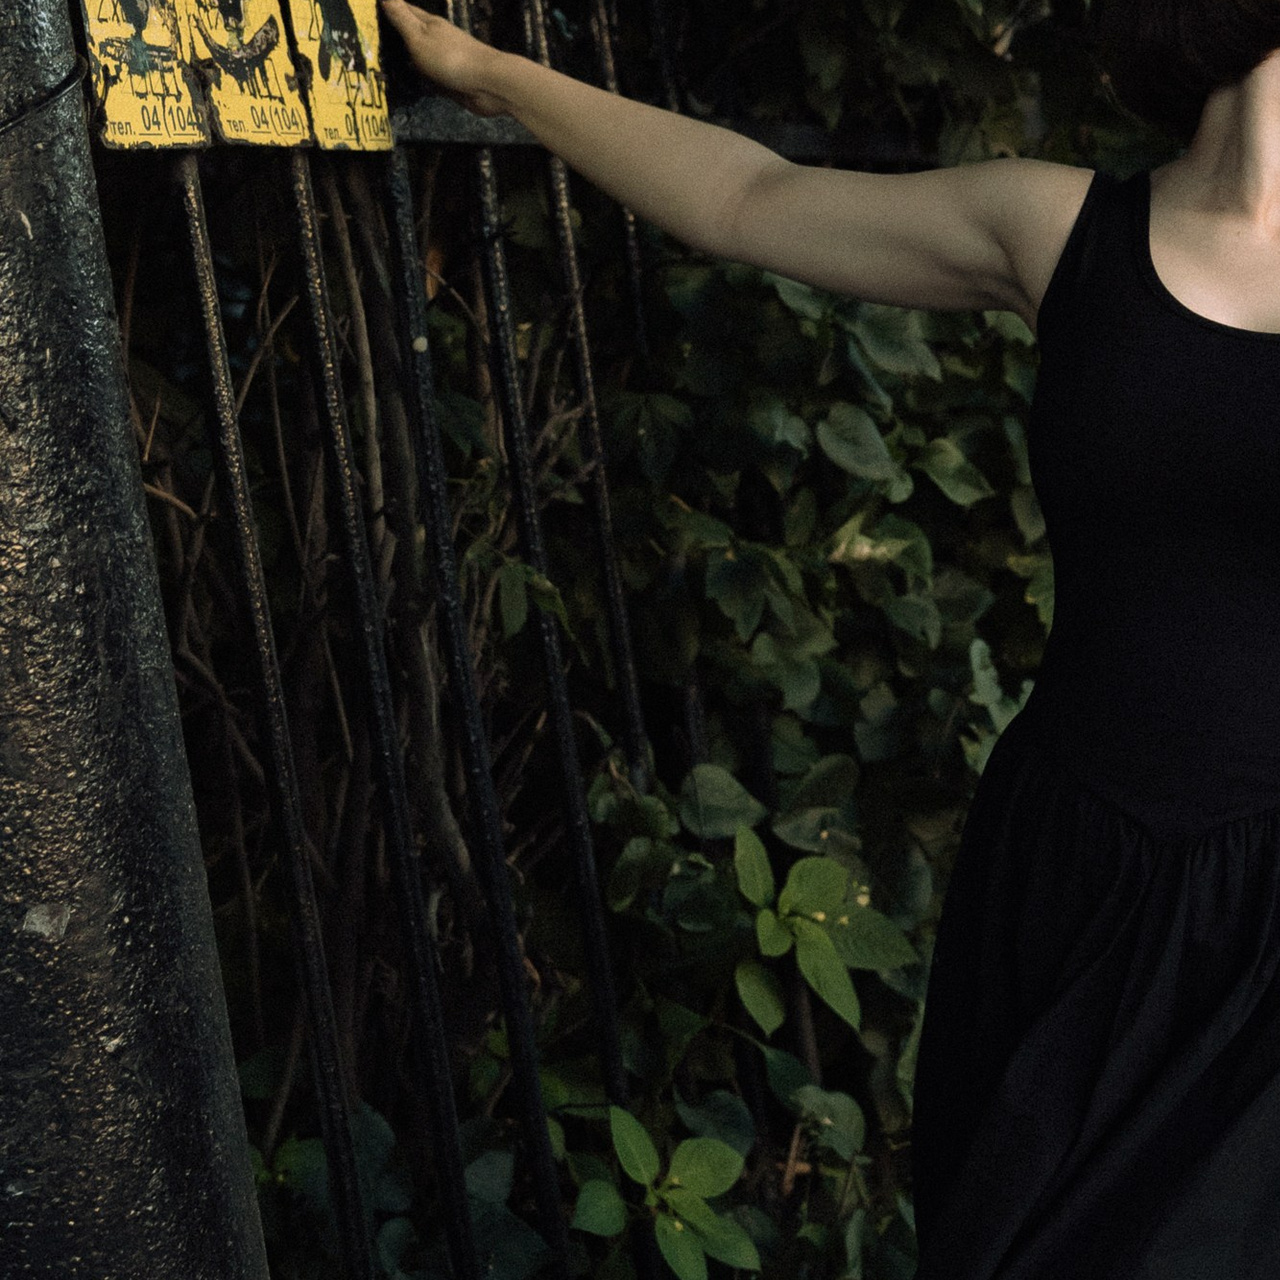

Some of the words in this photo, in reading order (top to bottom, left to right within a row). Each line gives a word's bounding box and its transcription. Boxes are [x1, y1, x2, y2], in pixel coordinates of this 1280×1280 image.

[108, 121, 136, 135] тел.
[141, 105, 161, 131] 04
[226, 119, 249, 133] тел.
[250, 105, 269, 129] 04
